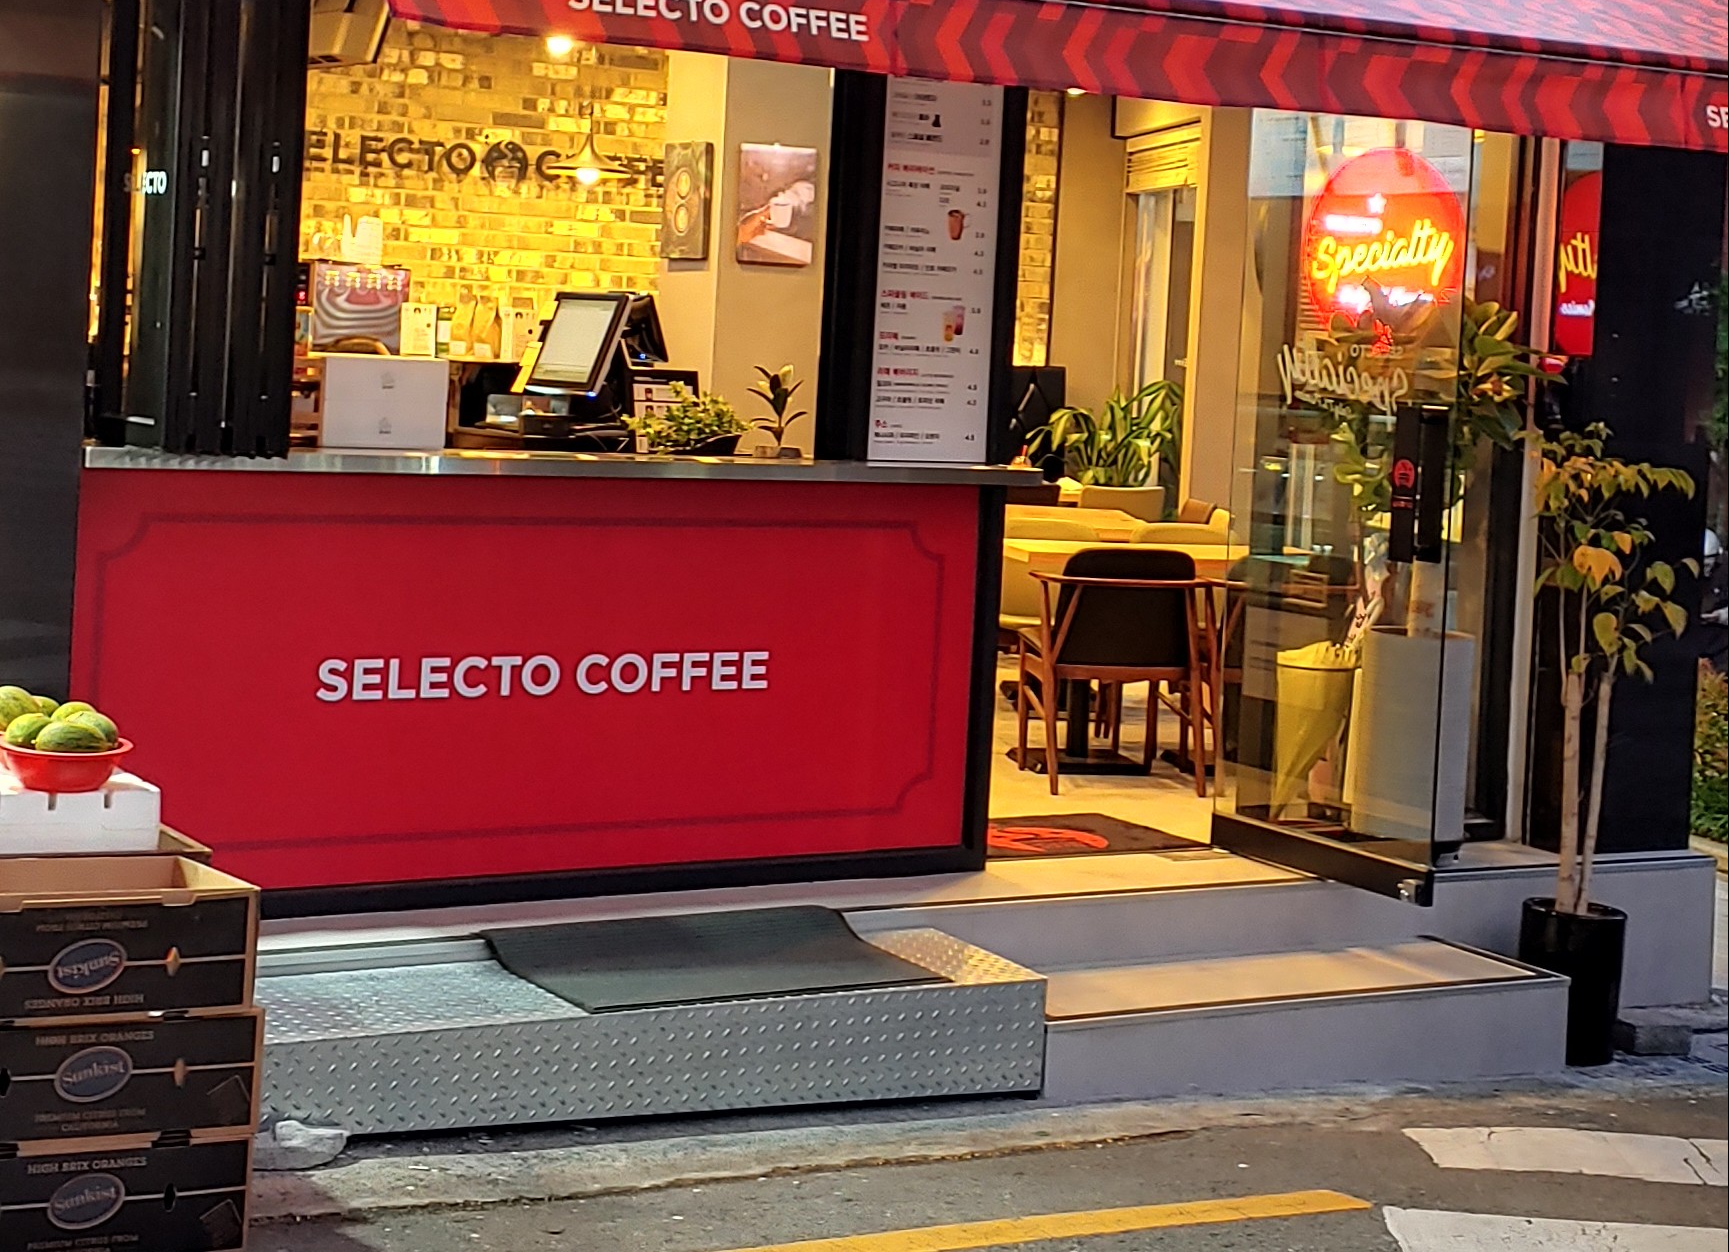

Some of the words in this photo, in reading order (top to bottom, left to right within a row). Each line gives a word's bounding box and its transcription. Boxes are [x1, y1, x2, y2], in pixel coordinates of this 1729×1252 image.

[739, 0, 869, 41] COFFEE
[1312, 218, 1454, 294] Specialty
[315, 654, 561, 702] SELECTO
[575, 651, 770, 695] COFFEE
[61, 1060, 127, 1087] Sunkist
[53, 1185, 118, 1215] Sunkist
